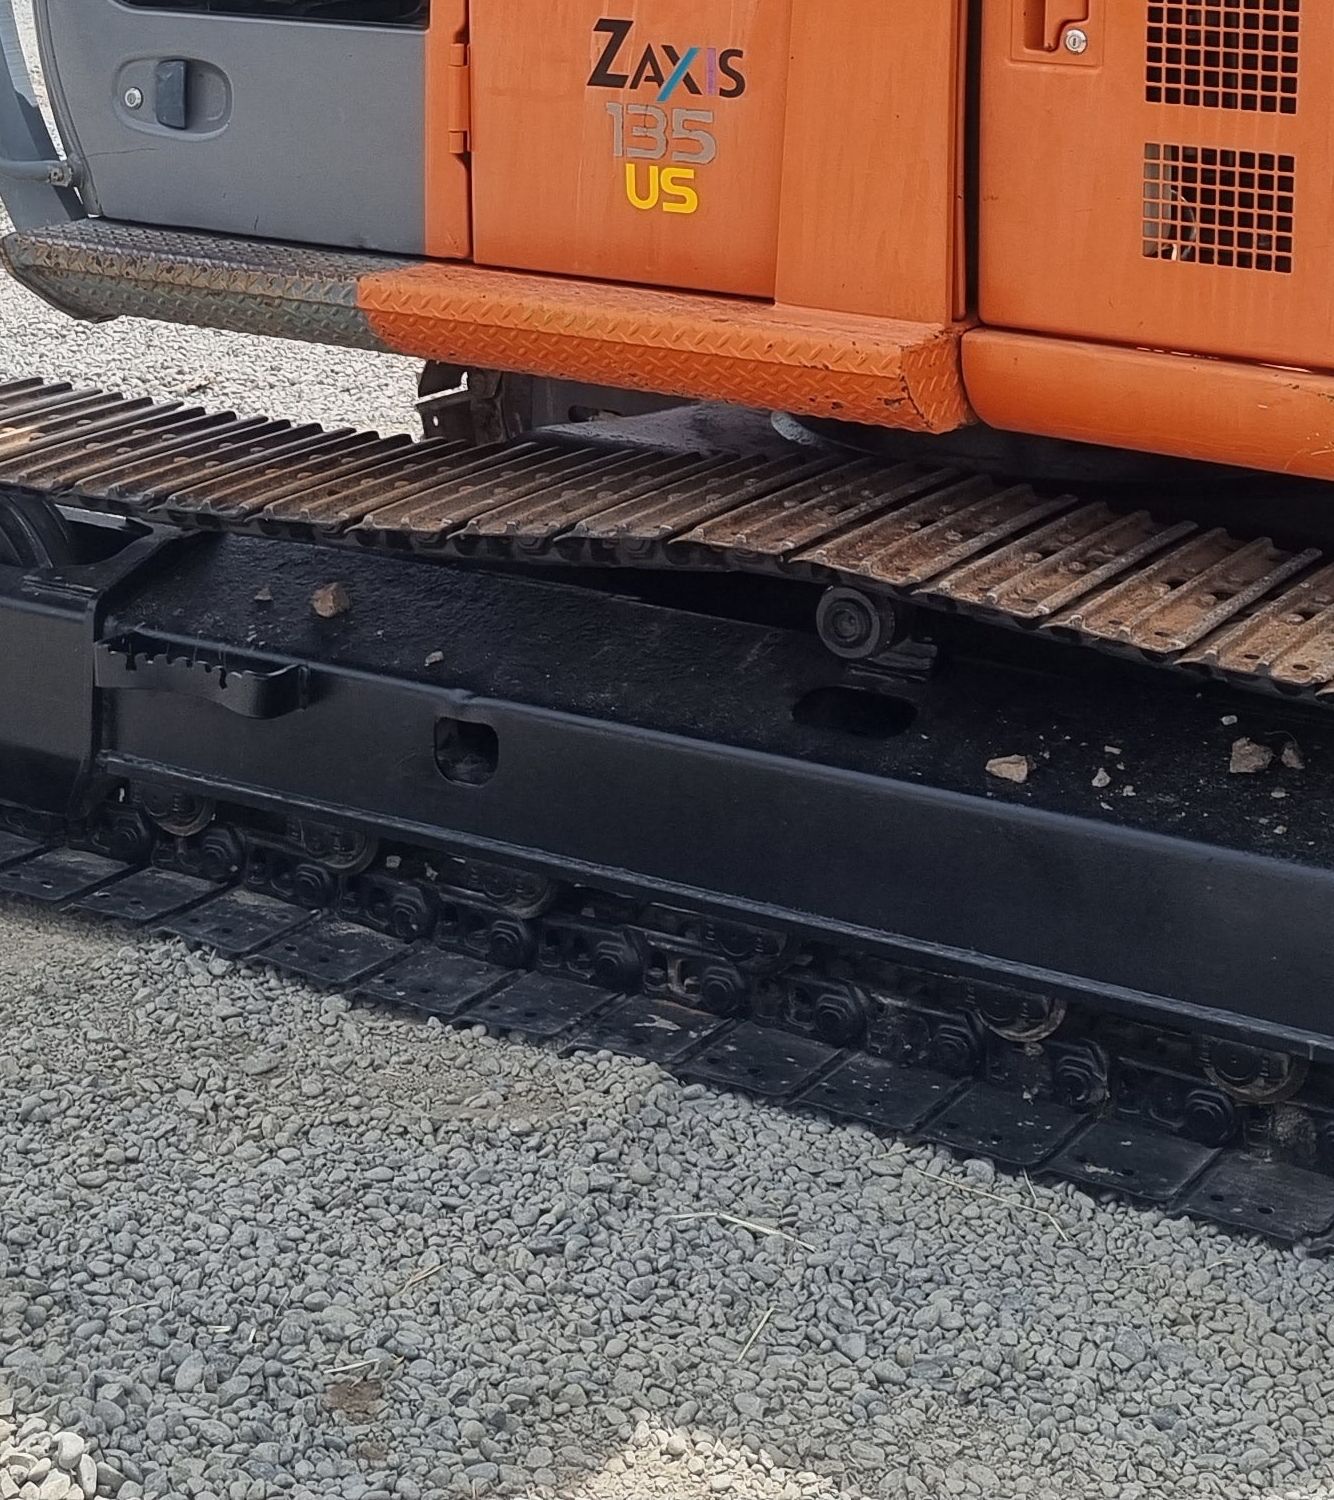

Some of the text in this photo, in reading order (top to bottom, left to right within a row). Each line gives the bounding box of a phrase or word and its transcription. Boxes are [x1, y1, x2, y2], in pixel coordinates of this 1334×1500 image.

[586, 17, 746, 102] ZAXIS
[605, 102, 718, 165] 135
[625, 163, 699, 214] US
